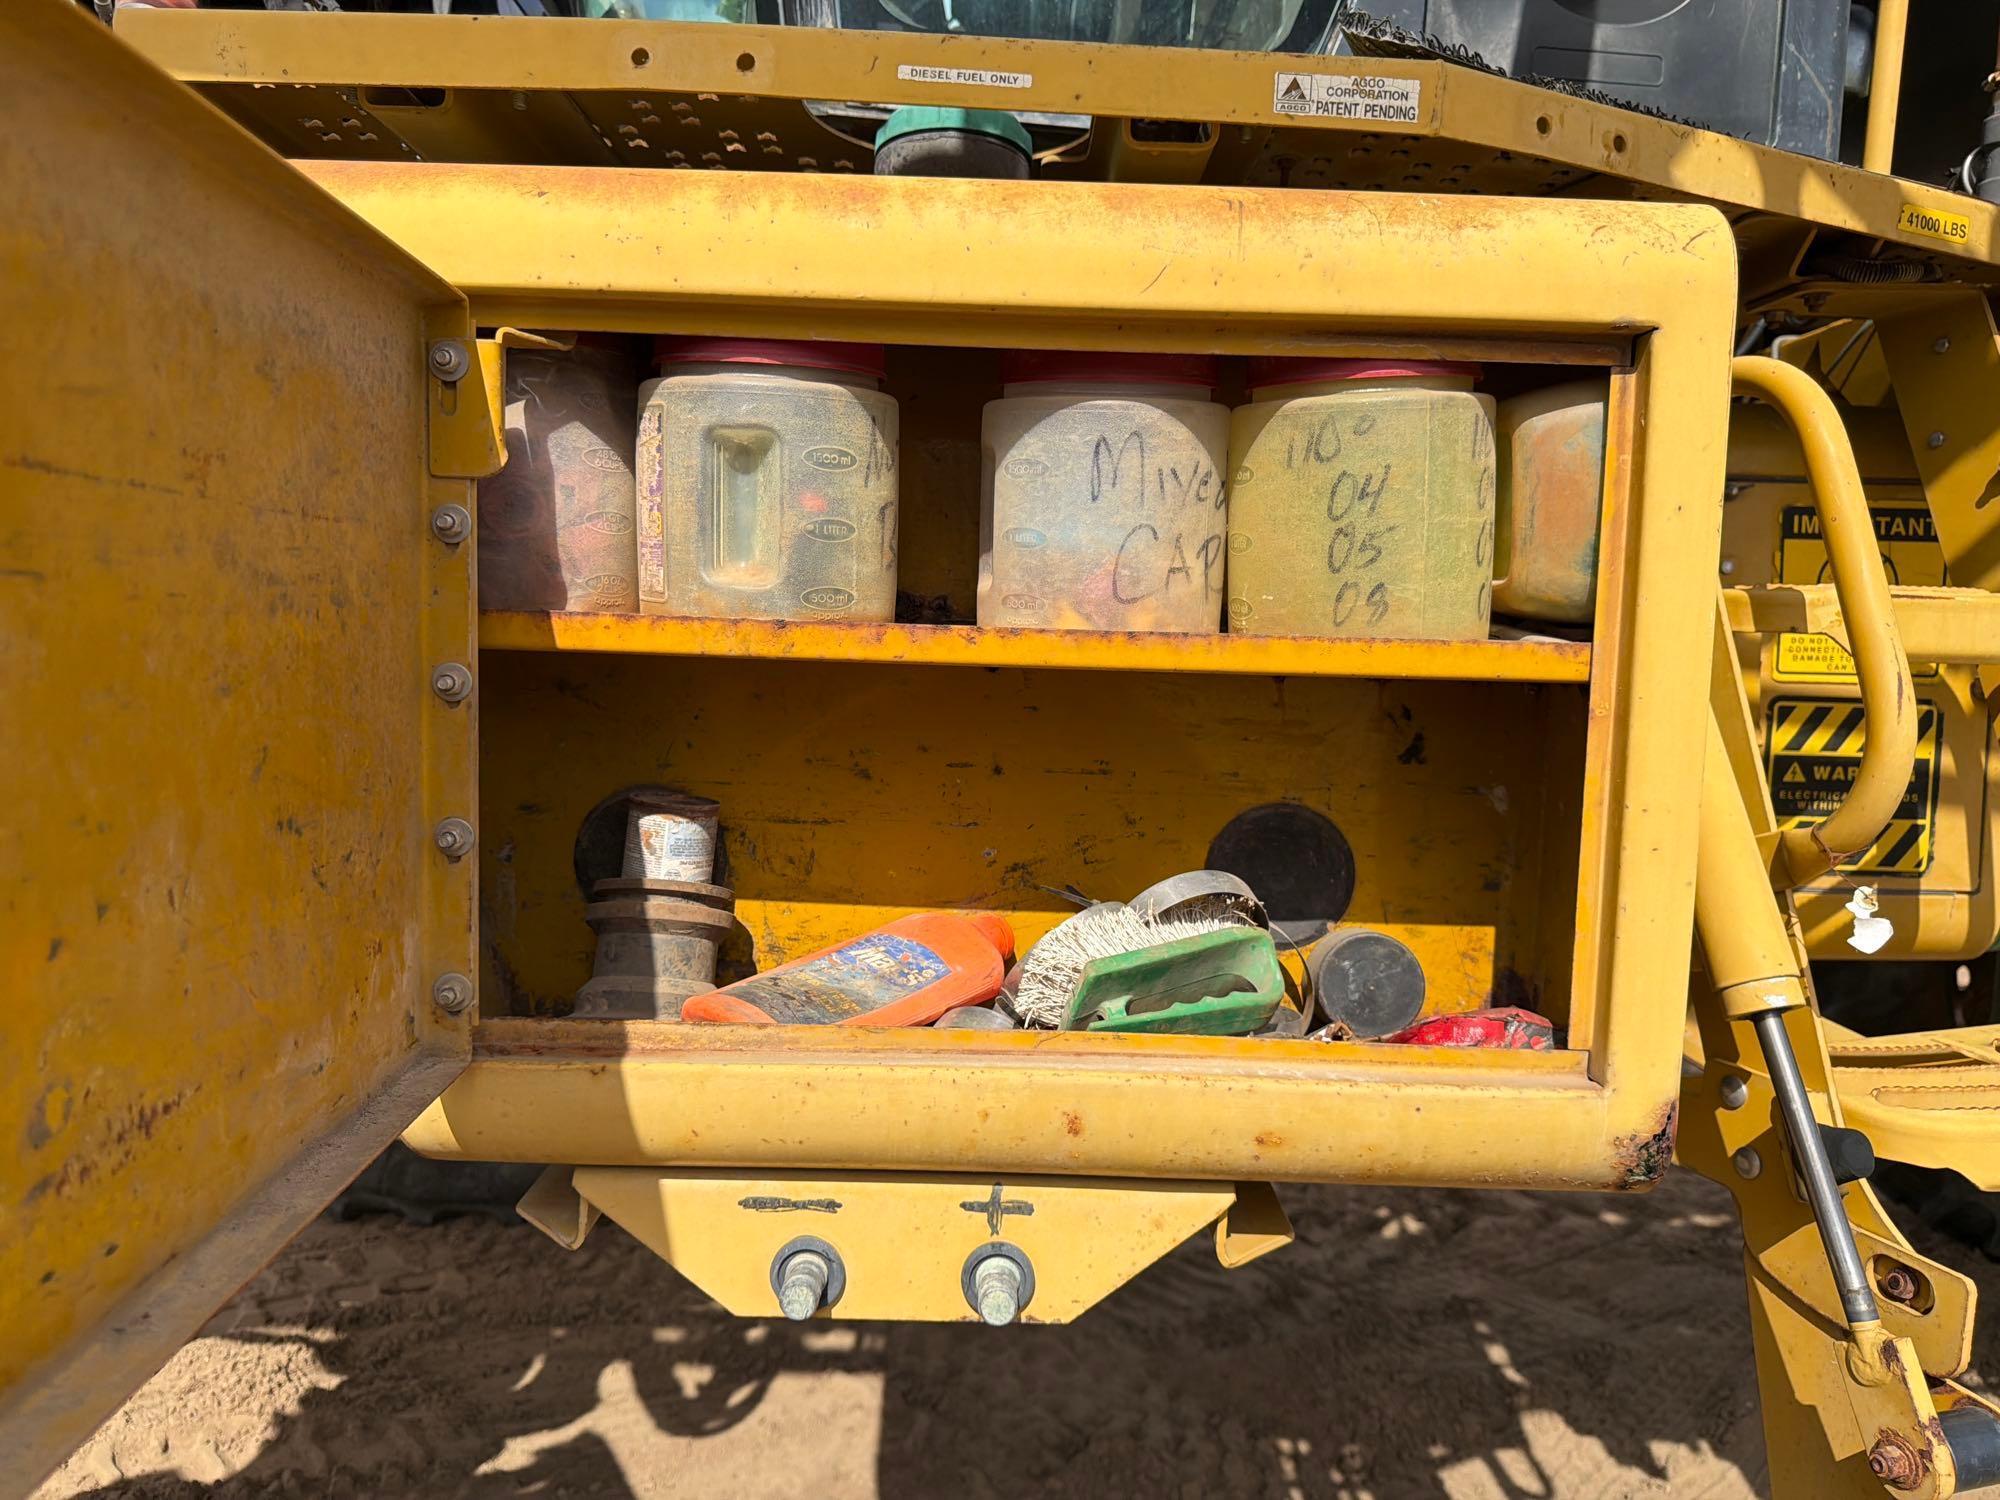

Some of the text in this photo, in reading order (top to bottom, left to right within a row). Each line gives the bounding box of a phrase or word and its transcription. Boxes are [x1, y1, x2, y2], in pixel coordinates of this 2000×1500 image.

[910, 68, 1019, 85] DIESEL FUEL ONLY
[1352, 77, 1385, 89] AGCO
[1326, 86, 1409, 101] CORPORATION
[1316, 100, 1416, 121] PATENT PENDING
[1907, 211, 1967, 239] 41000 LBS
[602, 459, 625, 470] CUPS
[813, 452, 851, 465] 1500 ml
[1327, 463, 1392, 521] 04
[1792, 514, 1937, 537] IMTANT
[1327, 521, 1400, 575] 05
[811, 594, 835, 603] 500
[1790, 637, 1828, 645] DO NOT
[1792, 654, 1835, 662] DAMAGE
[1827, 663, 1847, 671] CAN
